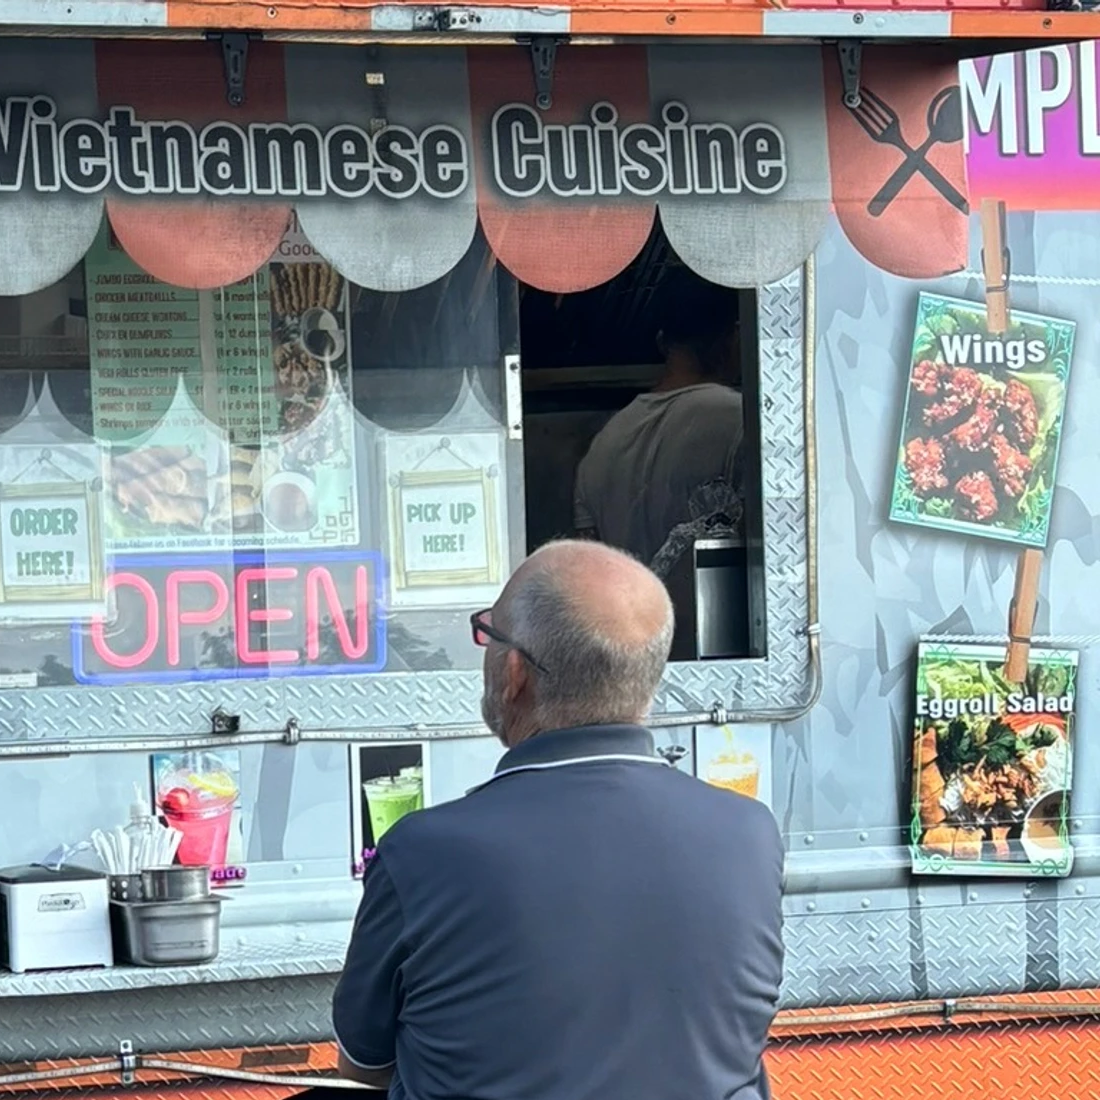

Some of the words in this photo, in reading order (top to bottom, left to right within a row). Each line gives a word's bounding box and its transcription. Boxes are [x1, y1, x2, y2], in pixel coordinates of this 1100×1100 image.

[492, 100, 788, 196] Cuisine
[940, 334, 1046, 368] Wings
[10, 507, 78, 537] ORDER
[407, 502, 442, 523] PICK
[449, 503, 476, 525] UP
[423, 533, 466, 553] HERE!
[17, 550, 75, 577] HERE!
[92, 565, 368, 669] OPEN
[916, 692, 998, 719] Eggroll
[1006, 692, 1073, 715] Salad
